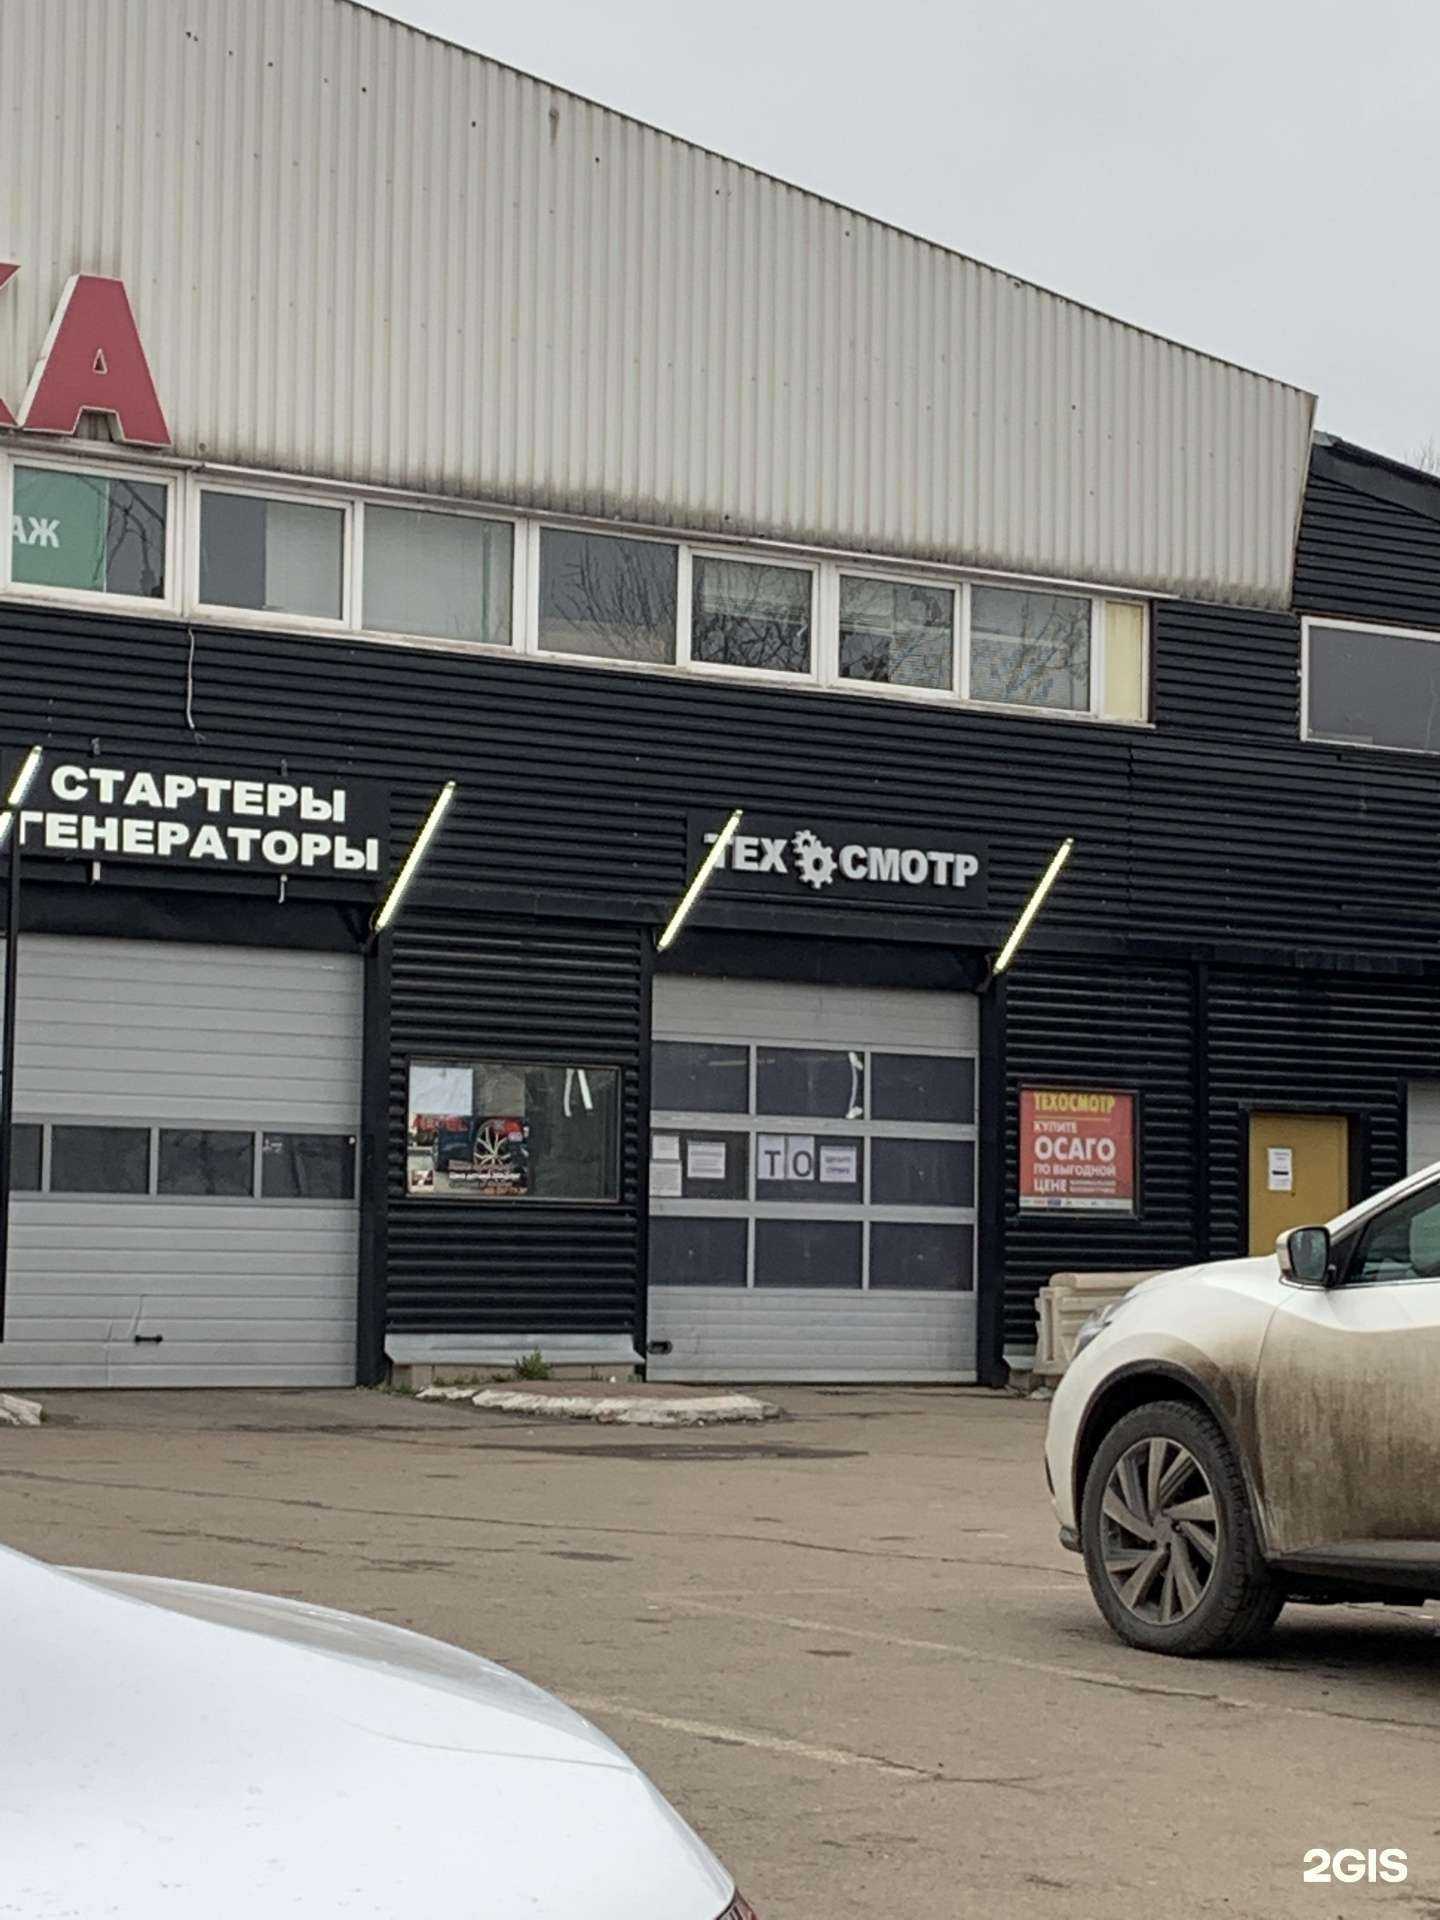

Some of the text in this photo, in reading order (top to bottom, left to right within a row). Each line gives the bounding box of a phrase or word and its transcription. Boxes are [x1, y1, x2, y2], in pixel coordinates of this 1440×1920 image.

[0, 262, 172, 447] А
[51, 765, 347, 823] СТАРТЕРЫ
[19, 811, 379, 872] ГЕНЕРАТОРЫ
[1033, 1092, 1116, 1114] ТЕХОСМОТР
[1034, 1136, 1116, 1161] ОСАГО
[1033, 1163, 1116, 1178] ПО ВЫГОДНОЙ
[1033, 1178, 1067, 1195] ЦЕНЕ
